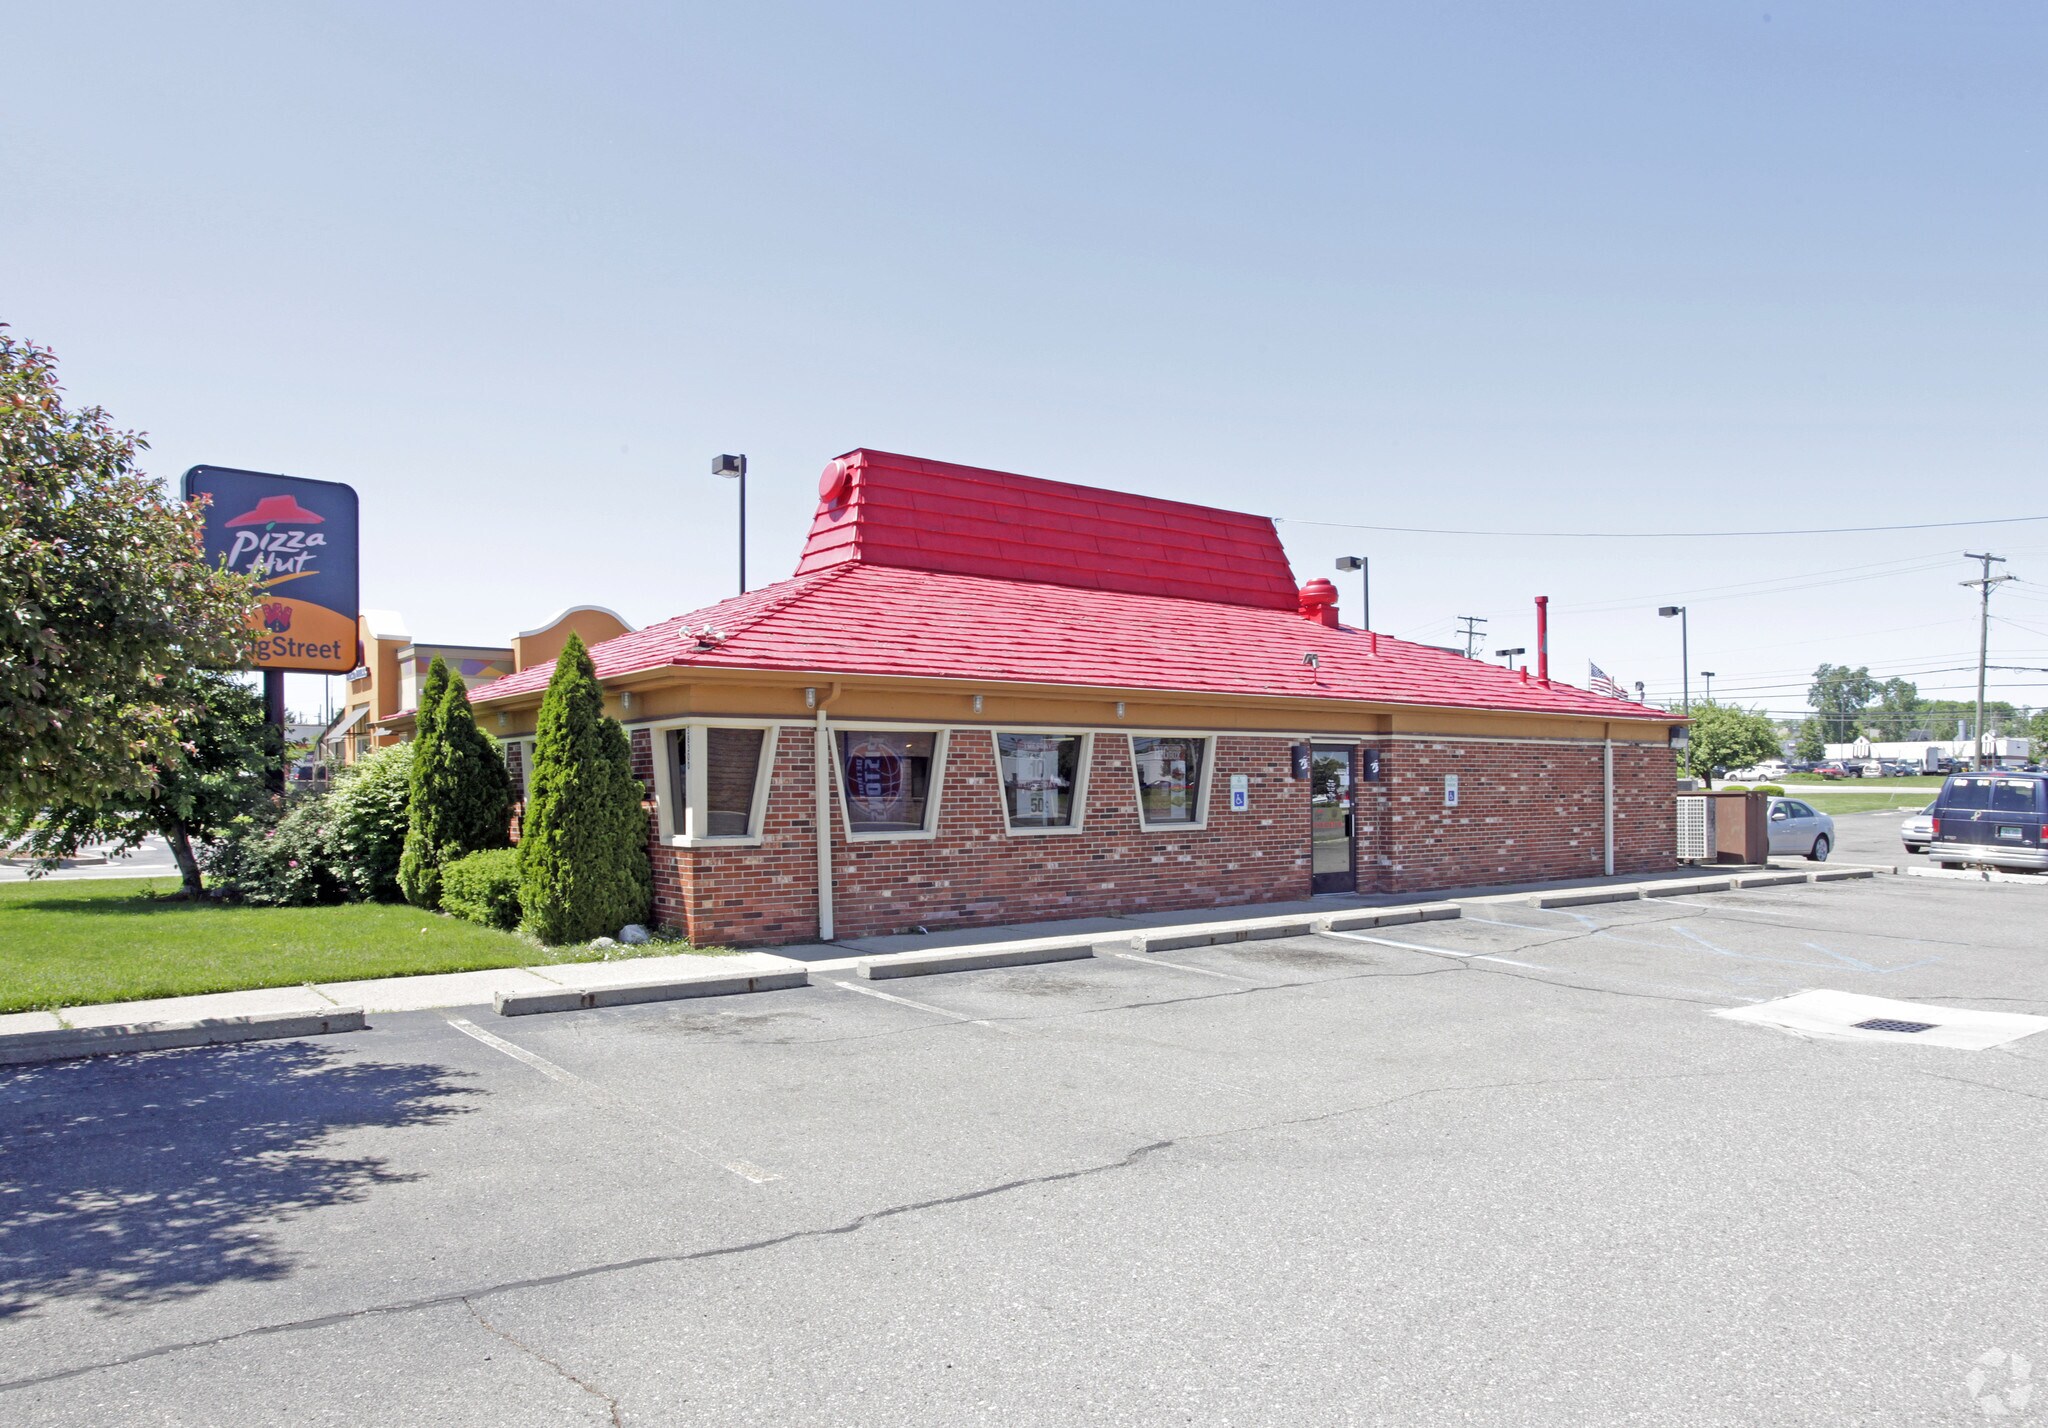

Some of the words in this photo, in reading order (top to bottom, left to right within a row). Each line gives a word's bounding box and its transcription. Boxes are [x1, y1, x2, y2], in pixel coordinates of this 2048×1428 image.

[228, 523, 327, 567] Pizza
[246, 550, 317, 575] Hut
[250, 636, 341, 660] gStreet
